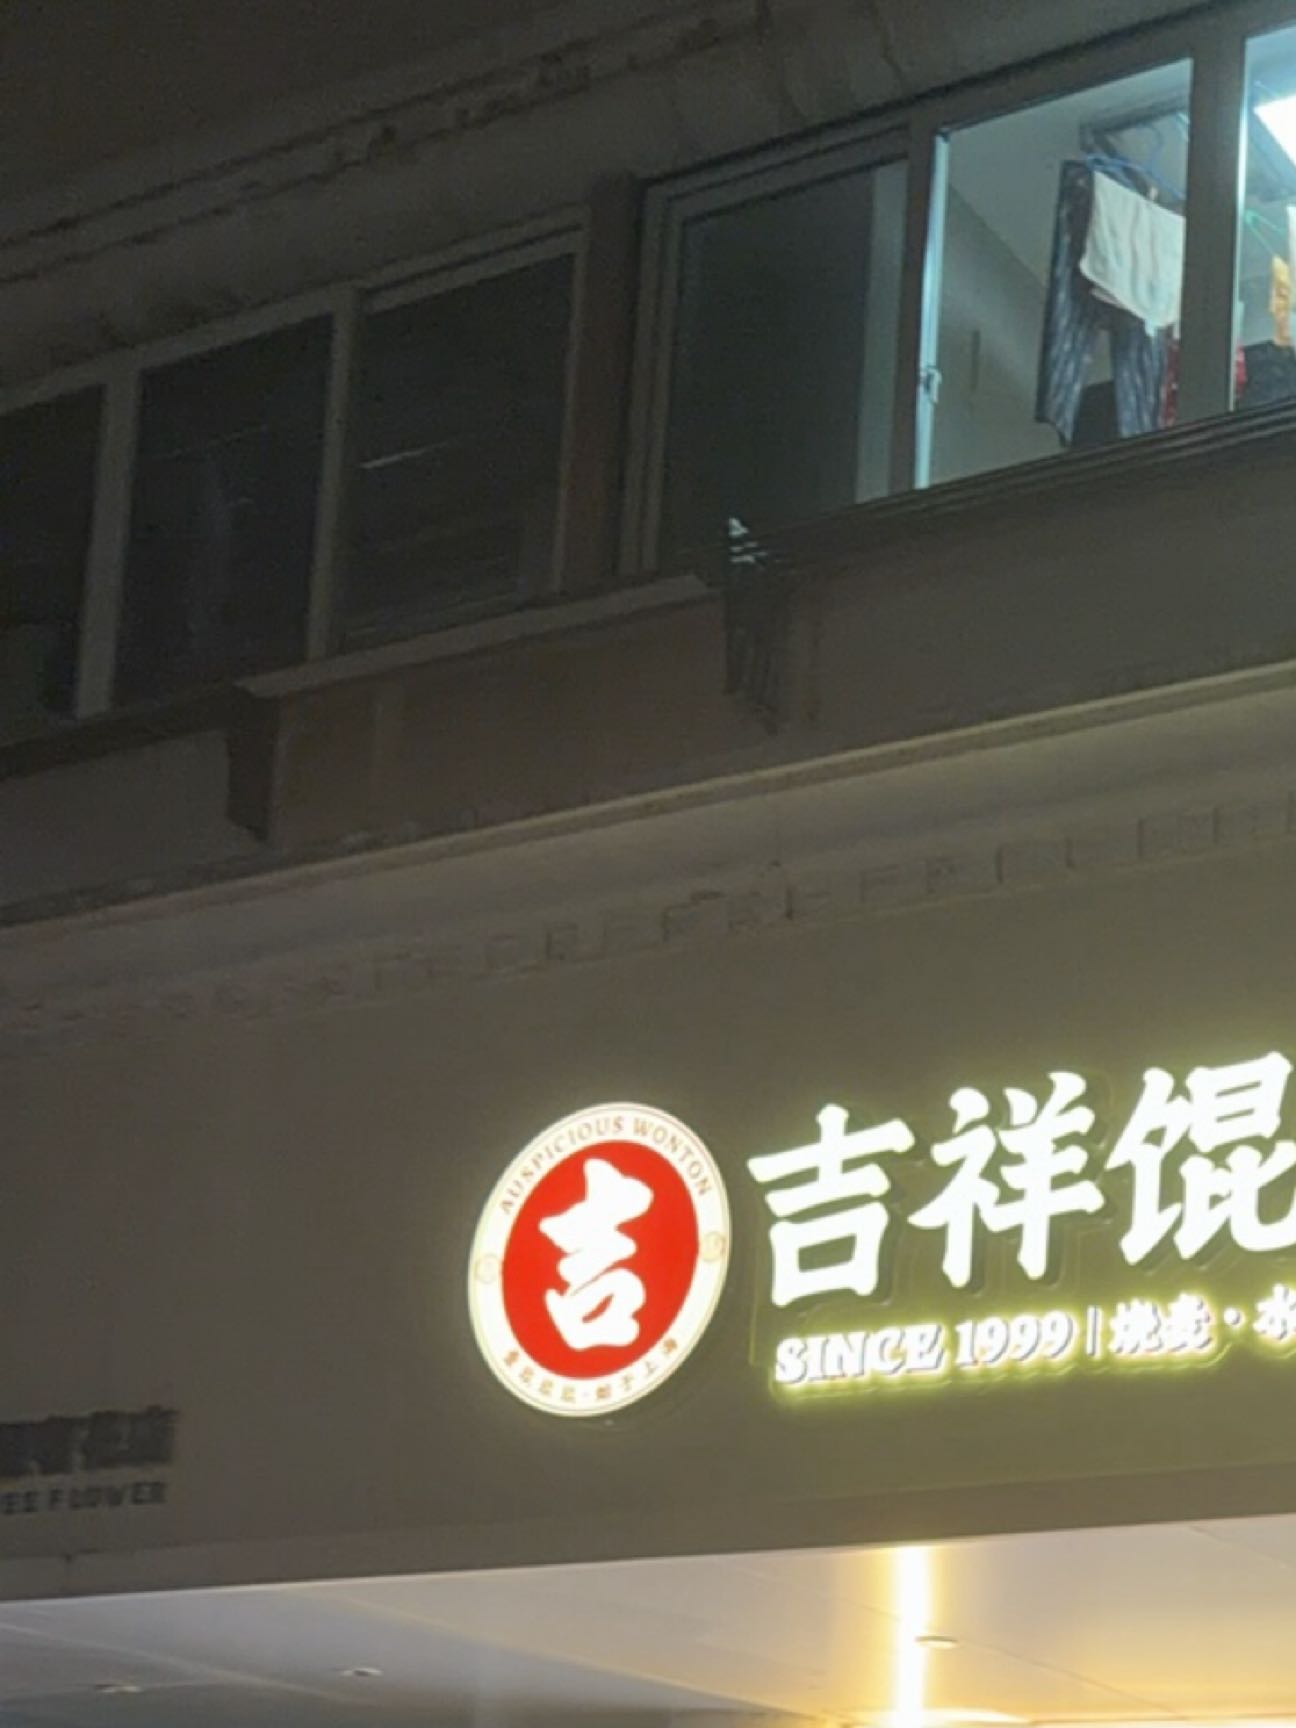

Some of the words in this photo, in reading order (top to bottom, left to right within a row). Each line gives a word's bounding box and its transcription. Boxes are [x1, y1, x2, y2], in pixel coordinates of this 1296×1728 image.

[500, 1115, 625, 1214] AUSPICIOUS
[632, 1116, 713, 1197] WONTON
[538, 1157, 654, 1352] 吉
[775, 1322, 944, 1385] SINCE
[956, 1309, 1076, 1369] 1999
